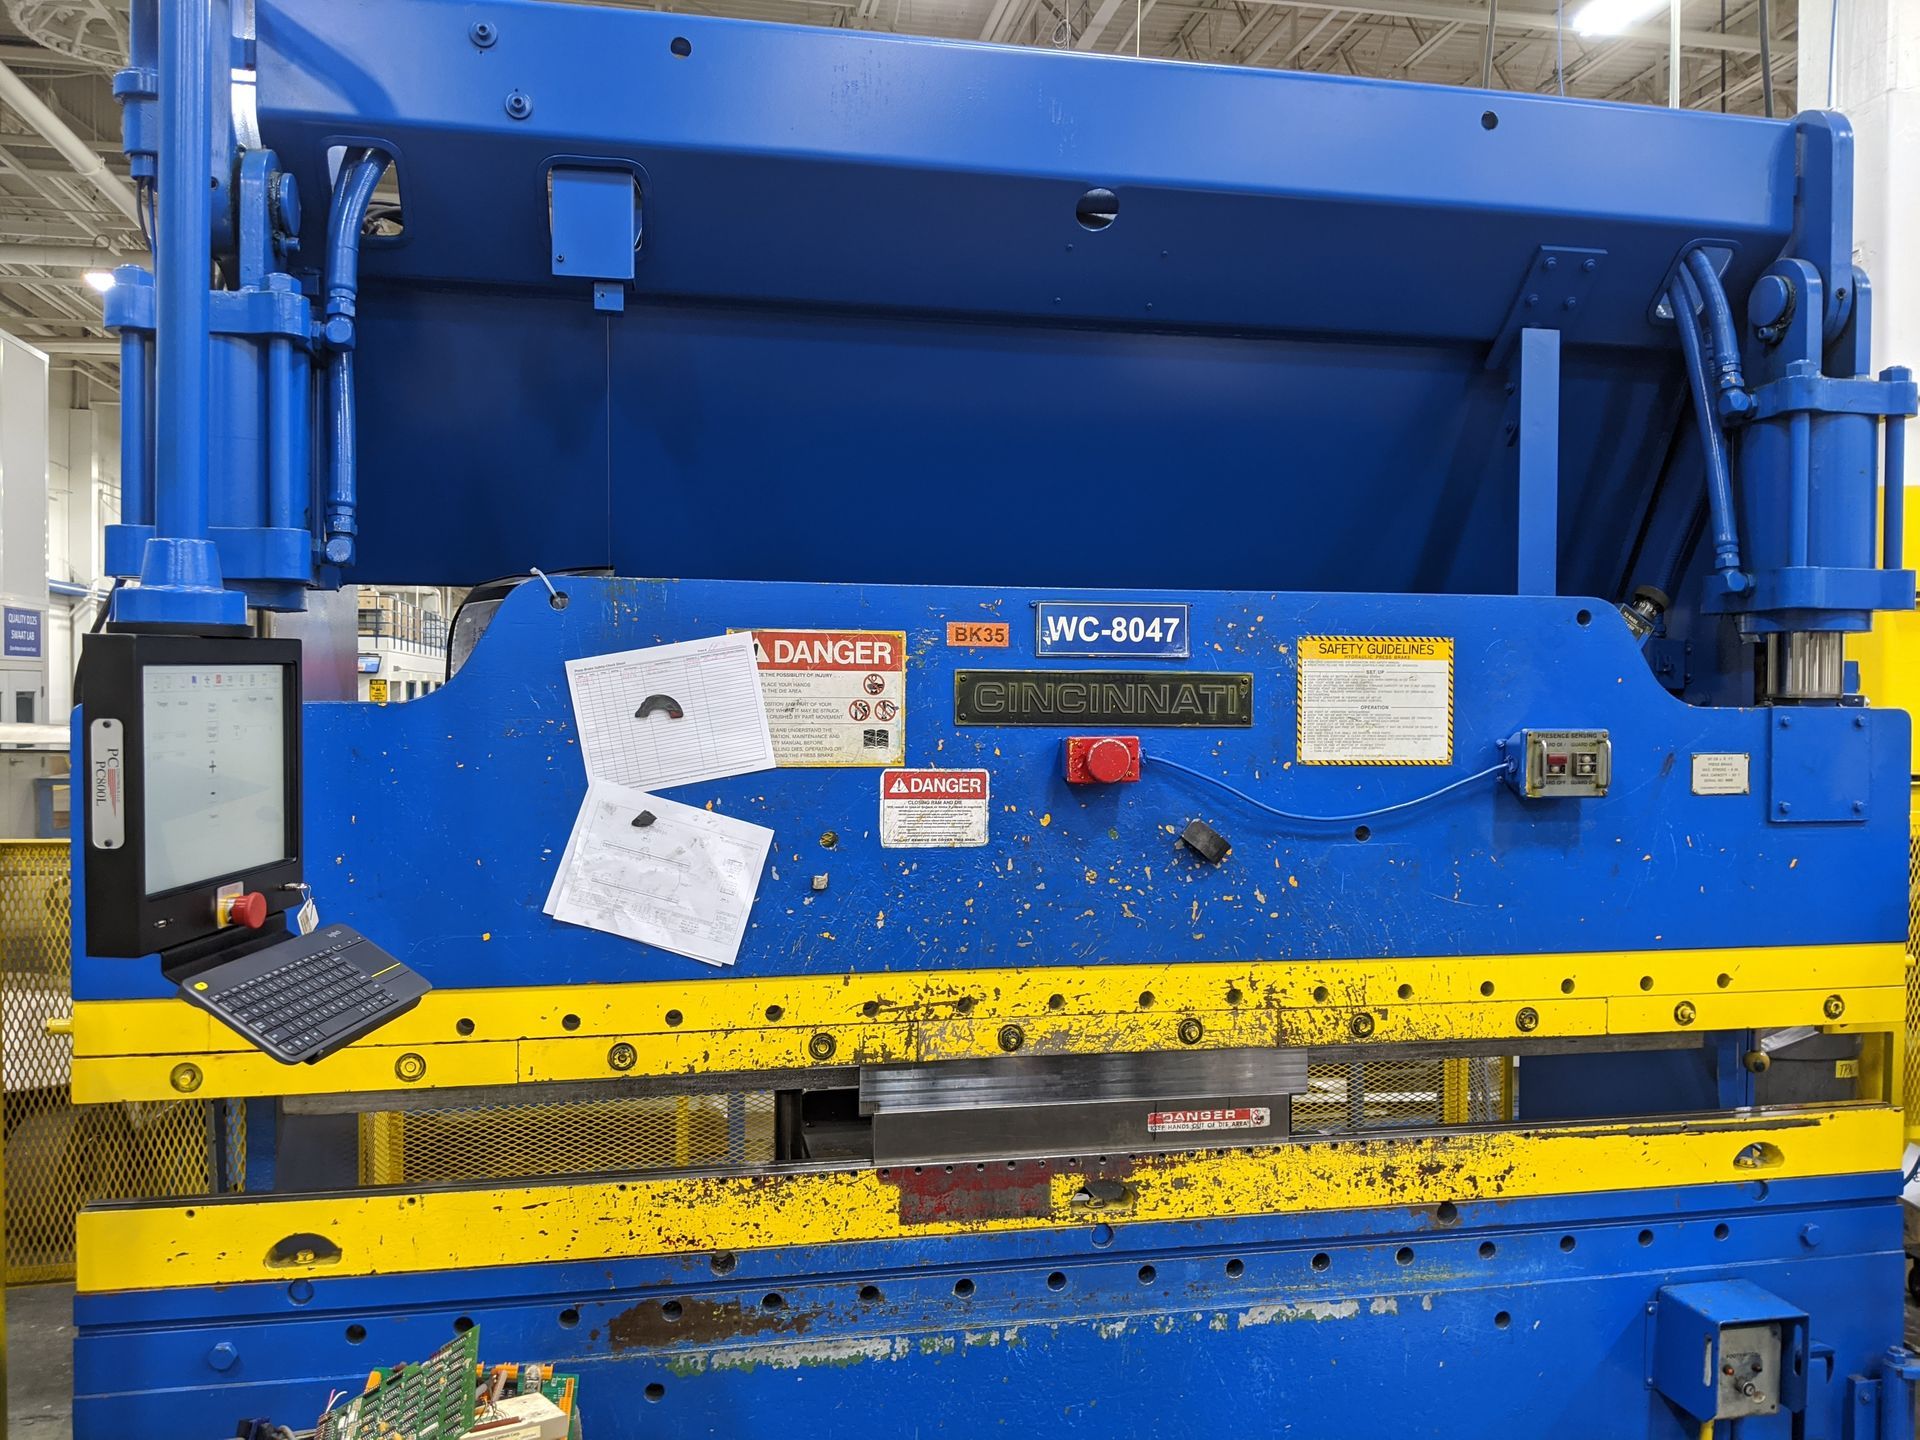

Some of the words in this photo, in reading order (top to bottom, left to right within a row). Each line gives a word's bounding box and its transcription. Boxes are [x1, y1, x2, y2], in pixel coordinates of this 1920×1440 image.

[955, 626, 1005, 643] BK35
[1047, 615, 1180, 643] WC-8047
[774, 640, 892, 665] DANGER
[1318, 643, 1364, 655] SAFETY
[1367, 643, 1435, 656] GUIDELINES
[973, 681, 1238, 715] CINCINNATI
[107, 748, 119, 768] PC
[95, 761, 107, 807] PC800L
[910, 778, 981, 793] DANGER
[1162, 1109, 1236, 1122] DANGER
